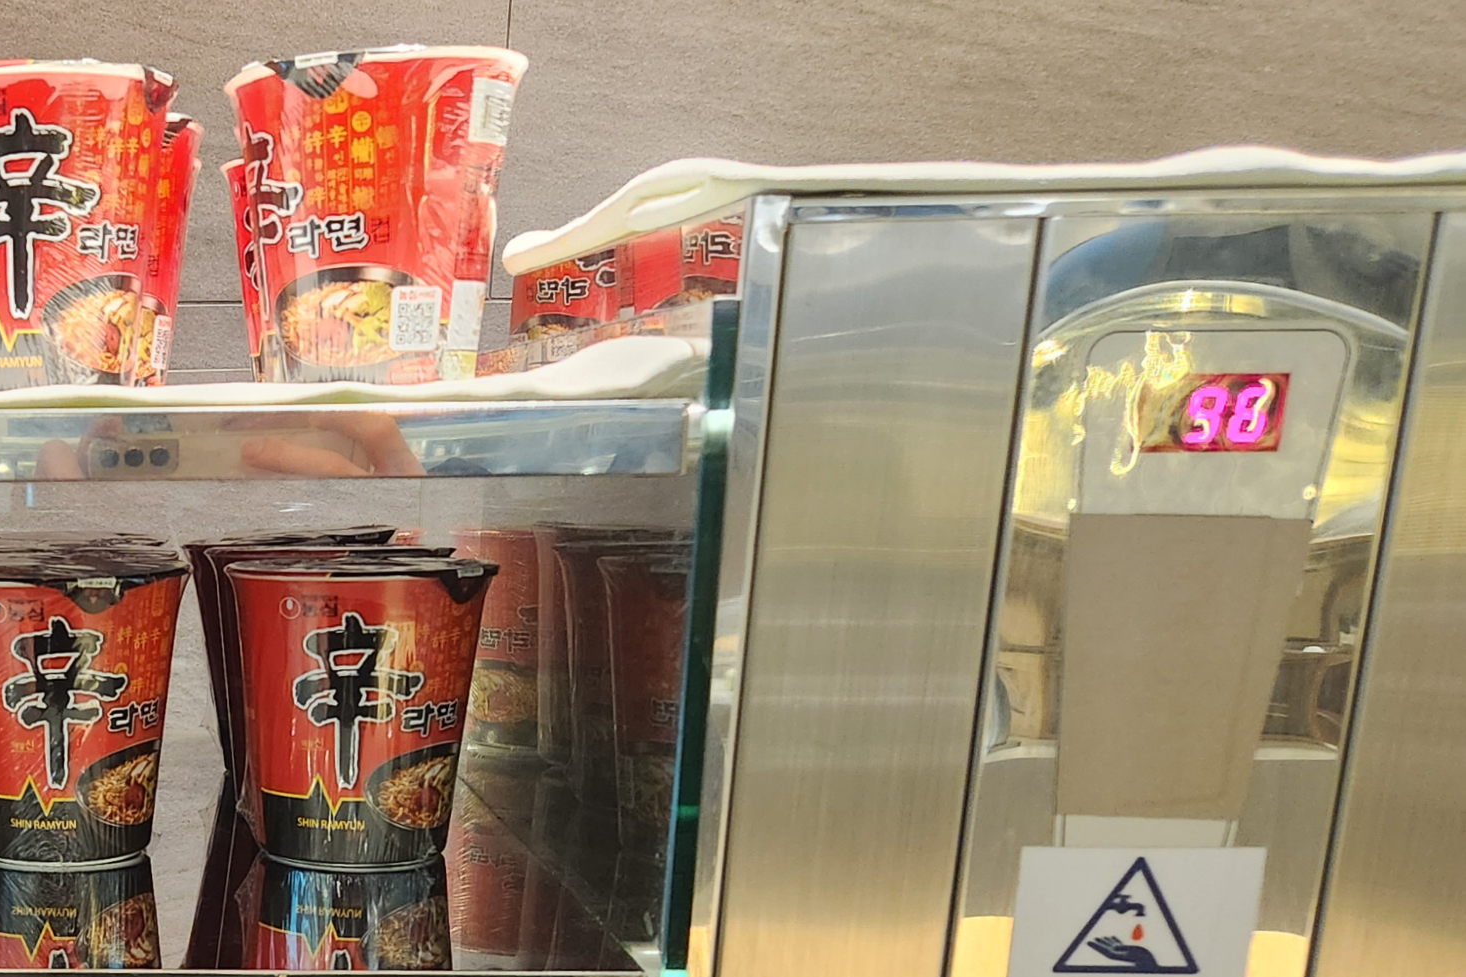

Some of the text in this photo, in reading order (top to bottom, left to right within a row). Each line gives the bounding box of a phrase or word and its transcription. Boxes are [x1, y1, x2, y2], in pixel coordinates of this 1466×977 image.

[1, 615, 129, 790] 辛
[292, 611, 425, 790] 辛
[10, 817, 78, 831] SHIN RAMYUN
[296, 816, 366, 831] SHIN RAMYUN
